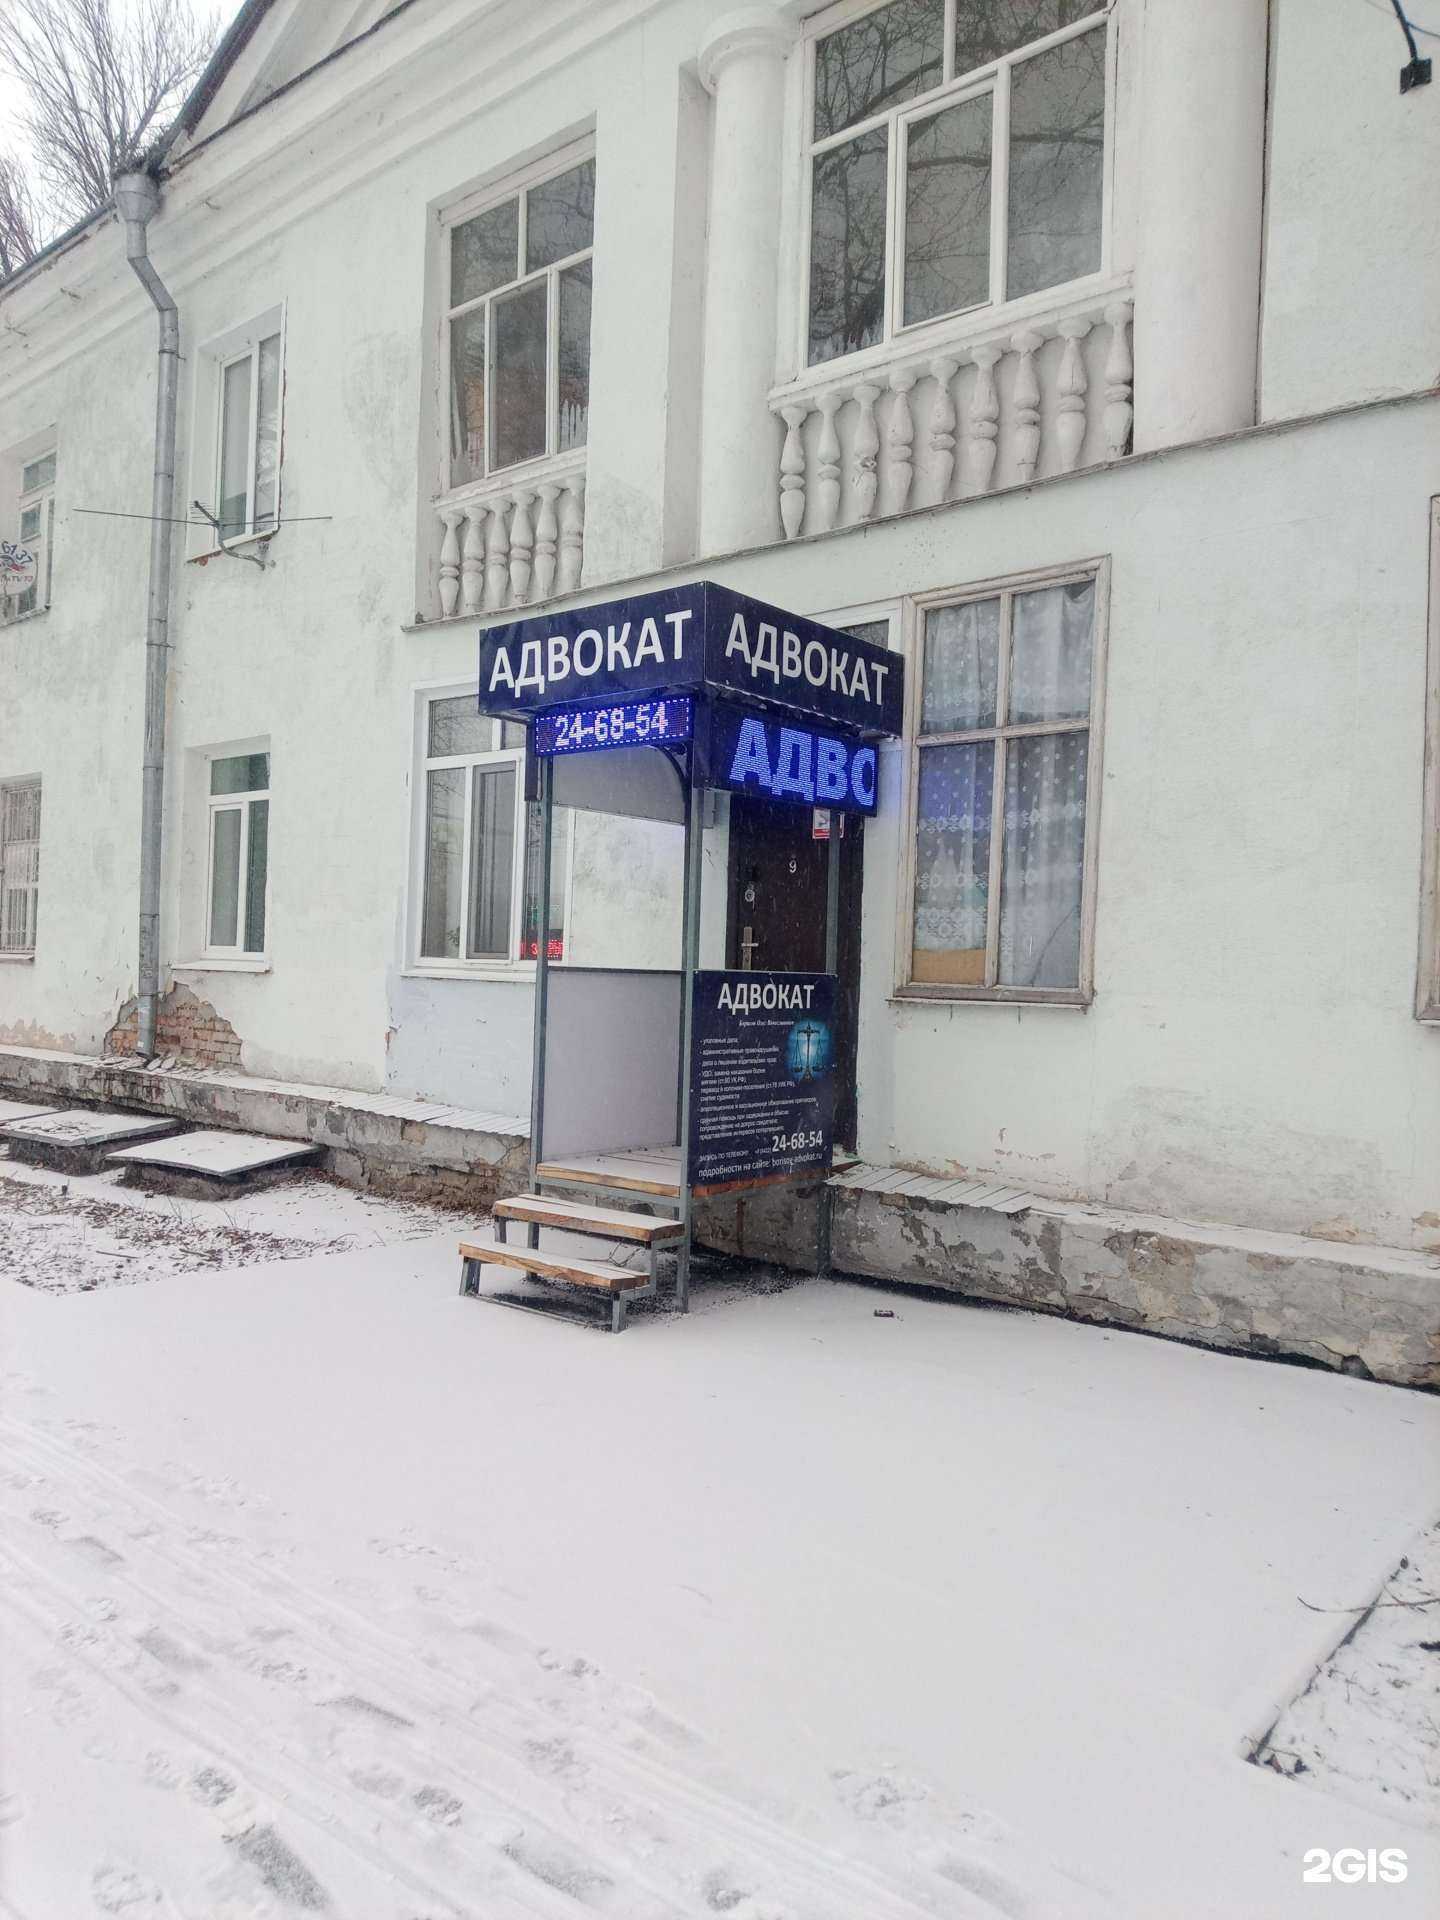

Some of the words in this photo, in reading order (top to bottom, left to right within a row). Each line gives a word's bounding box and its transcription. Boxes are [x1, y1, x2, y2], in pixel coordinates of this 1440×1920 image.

[489, 609, 692, 698] АДВОКАТ
[725, 613, 889, 706] АДВОКАТ
[554, 702, 668, 747] 24-68-54
[788, 859, 797, 874] 9
[717, 982, 815, 1016] АДВОКАТ
[772, 1130, 823, 1153] 24-68-54
[698, 1164, 742, 1178] подробности
[743, 1163, 751, 1171] на
